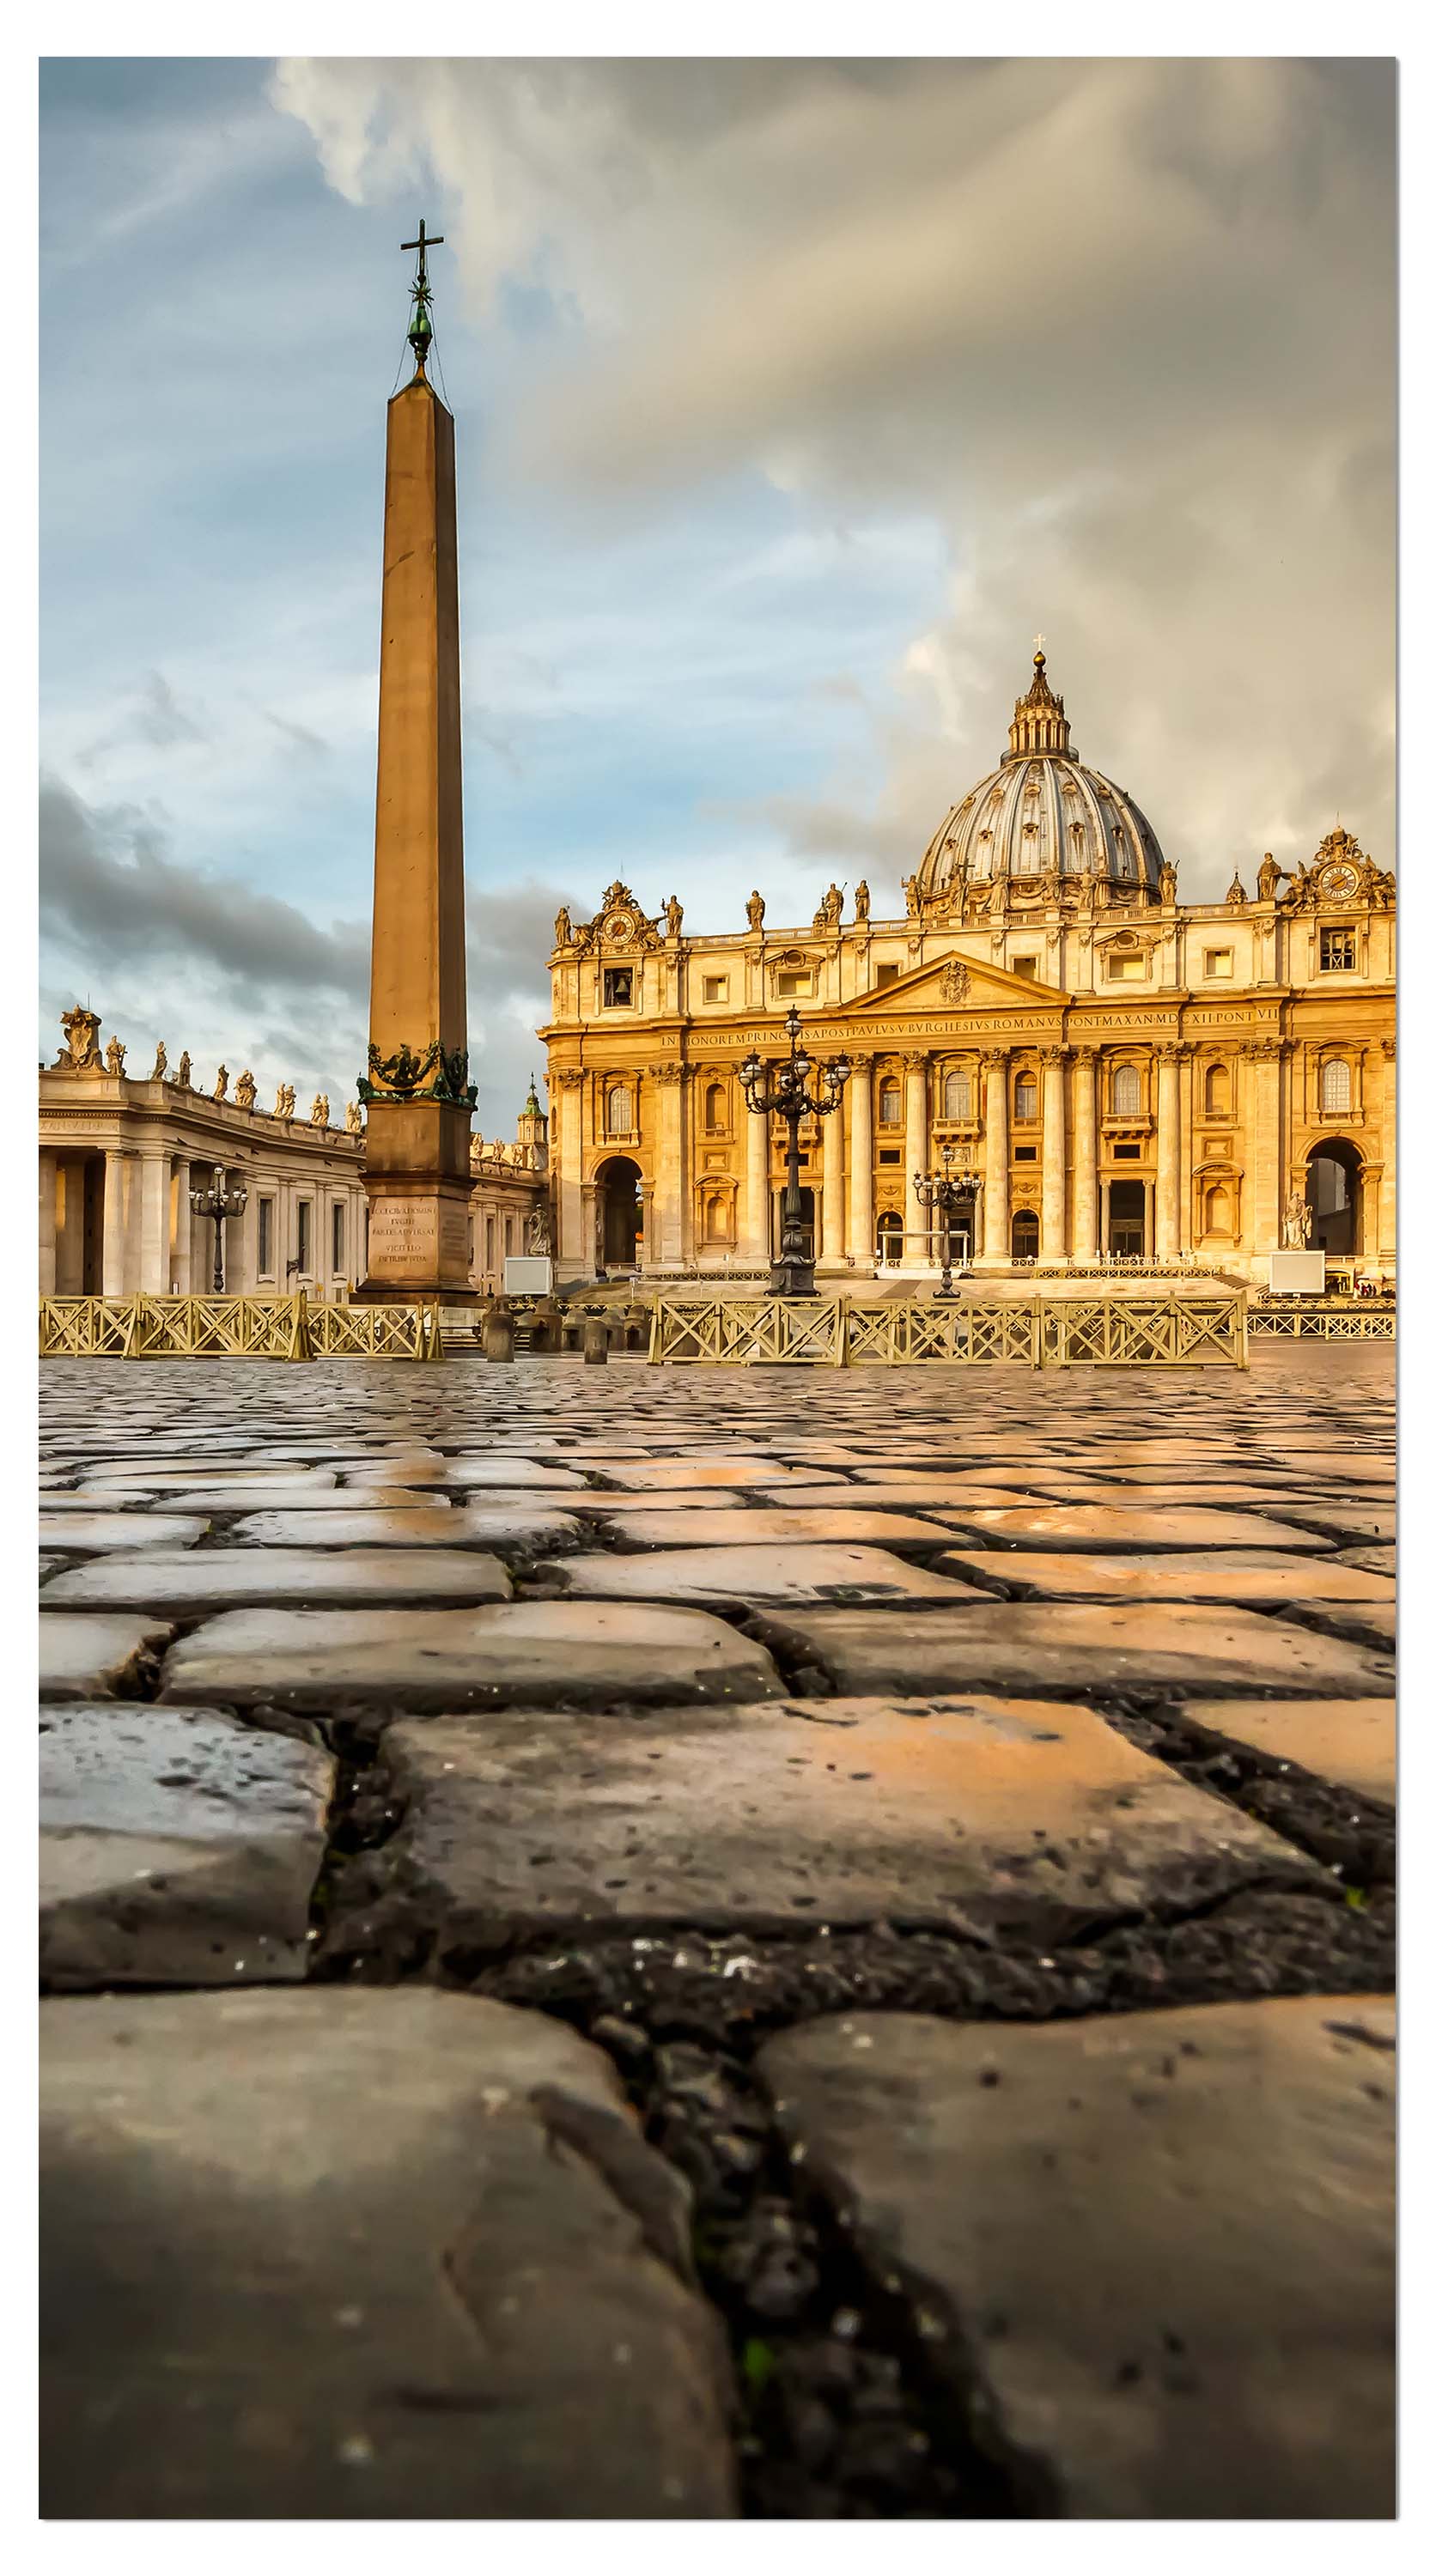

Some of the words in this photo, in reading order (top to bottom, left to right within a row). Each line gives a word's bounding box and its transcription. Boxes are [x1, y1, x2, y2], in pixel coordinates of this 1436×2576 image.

[661, 1036, 675, 1046] IN
[683, 1034, 745, 1046] HONOREM
[747, 1030, 810, 1042] PRINCIS
[993, 1017, 1062, 1030] ROMANVS
[1216, 1012, 1253, 1023] PONT
[1257, 1008, 1278, 1019] VII
